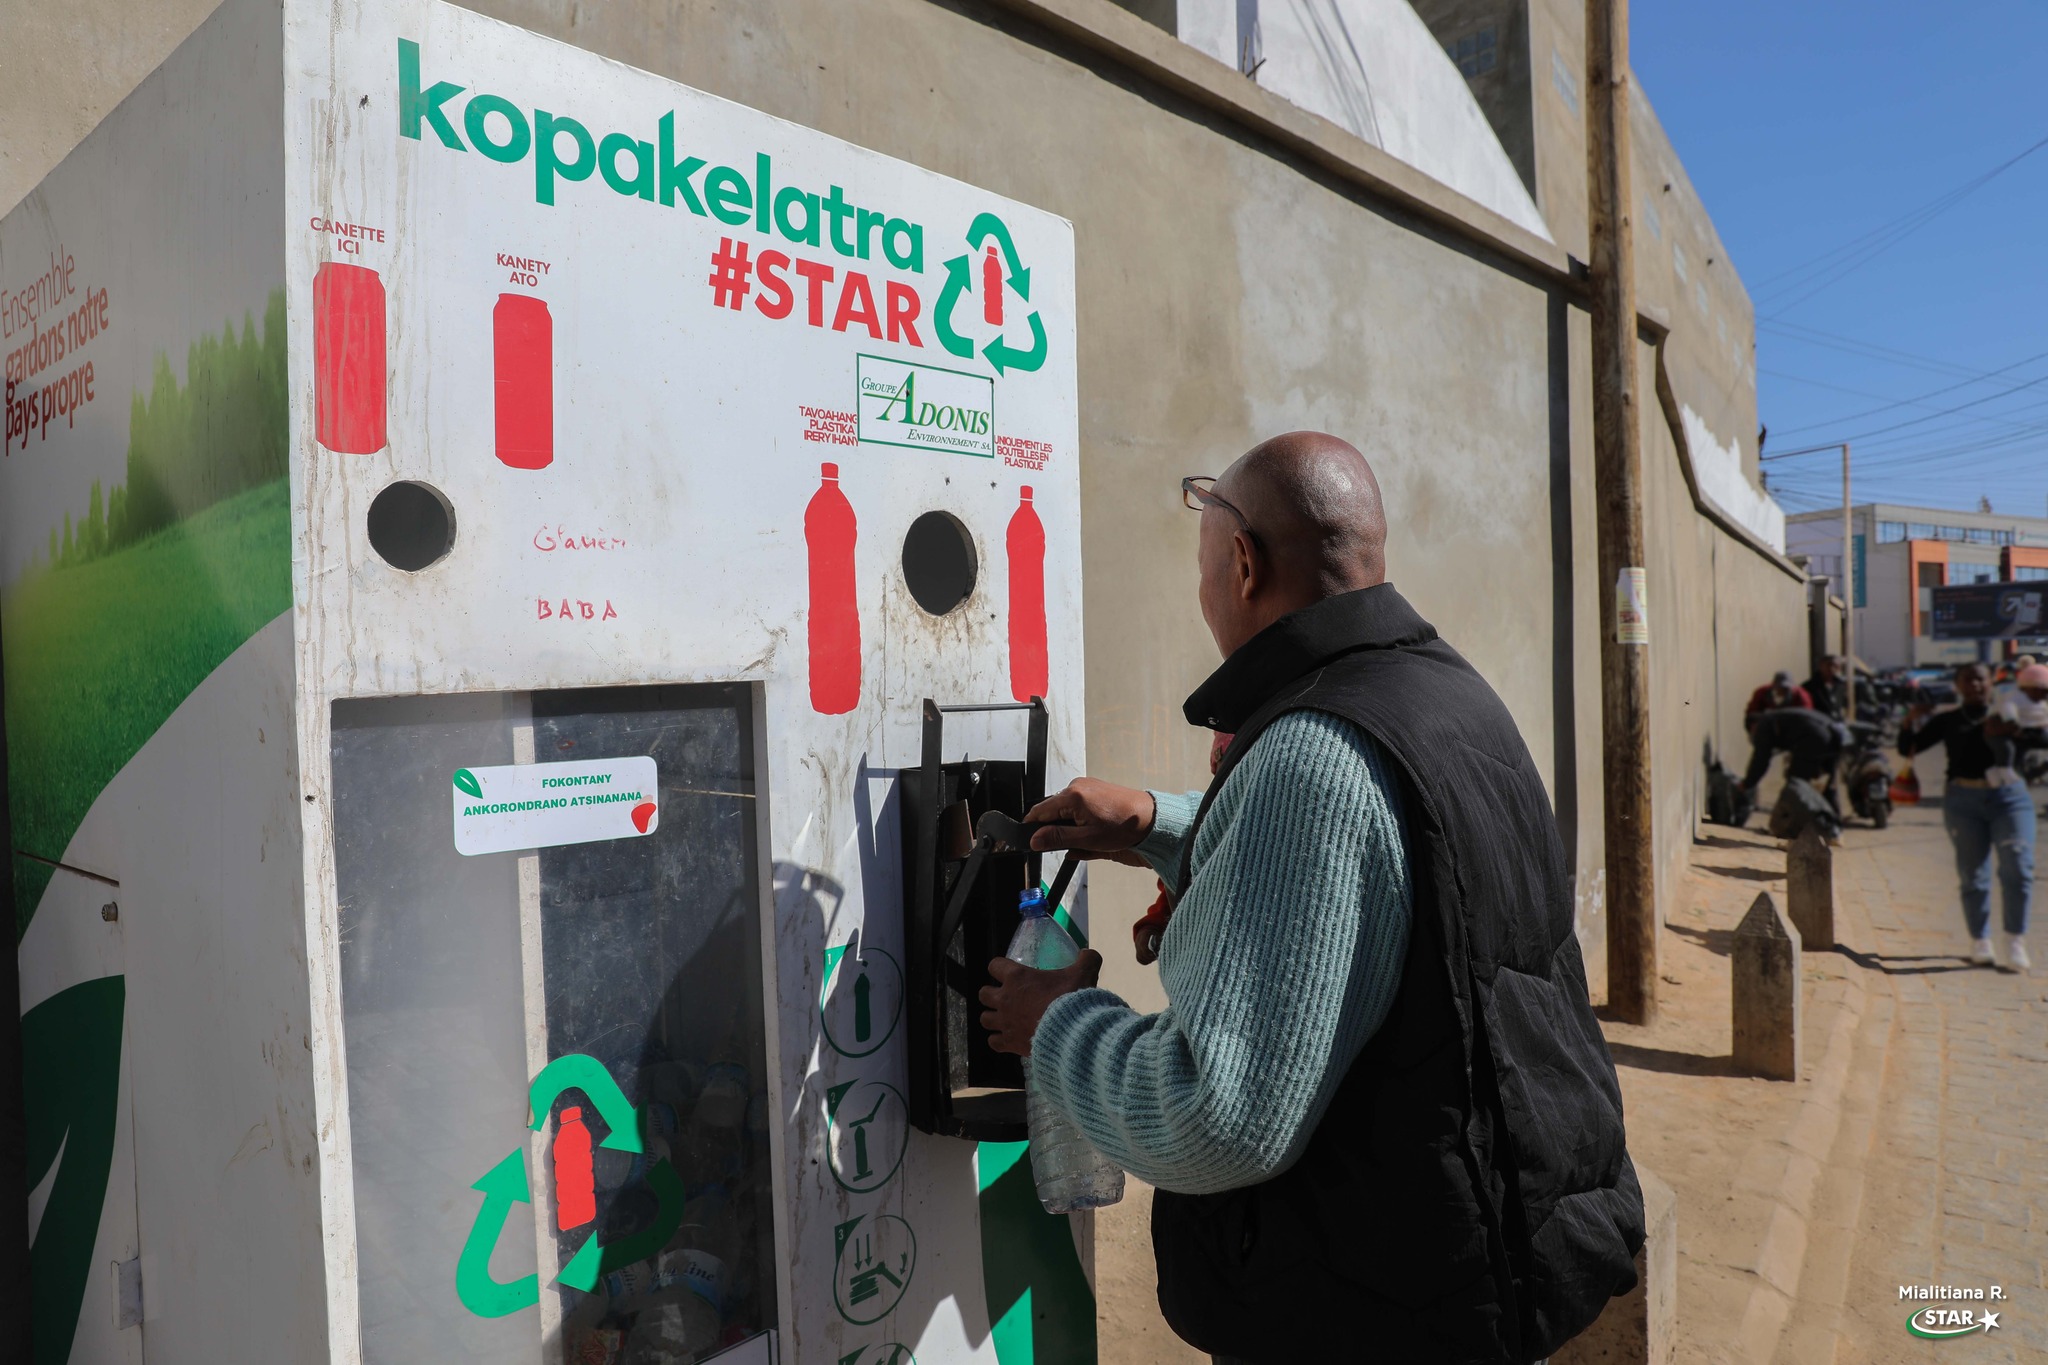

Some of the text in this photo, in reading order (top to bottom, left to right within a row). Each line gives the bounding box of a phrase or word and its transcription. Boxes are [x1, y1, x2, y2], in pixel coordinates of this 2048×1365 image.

[398, 38, 923, 274] kopakelatra
[310, 217, 385, 243] CANETTE
[337, 239, 360, 255] ICI
[496, 253, 551, 275] KANETY
[509, 271, 538, 287] ATO
[1, 244, 76, 341] Ensemble
[708, 236, 924, 347] #STAR
[5, 285, 109, 406] gardons notre
[5, 360, 95, 457] pays propre
[804, 429, 831, 443] IRERY
[809, 419, 856, 435] PLASTIKA
[994, 435, 1053, 453] UNIQUEMENT LES
[996, 445, 1049, 462] BOUTEILLES EN
[1004, 456, 1044, 471] PLASTIQUE
[537, 596, 618, 622] BABA
[542, 773, 612, 789] FOKONTANY
[463, 791, 643, 817] ANKORONDRANO ATSINANANA
